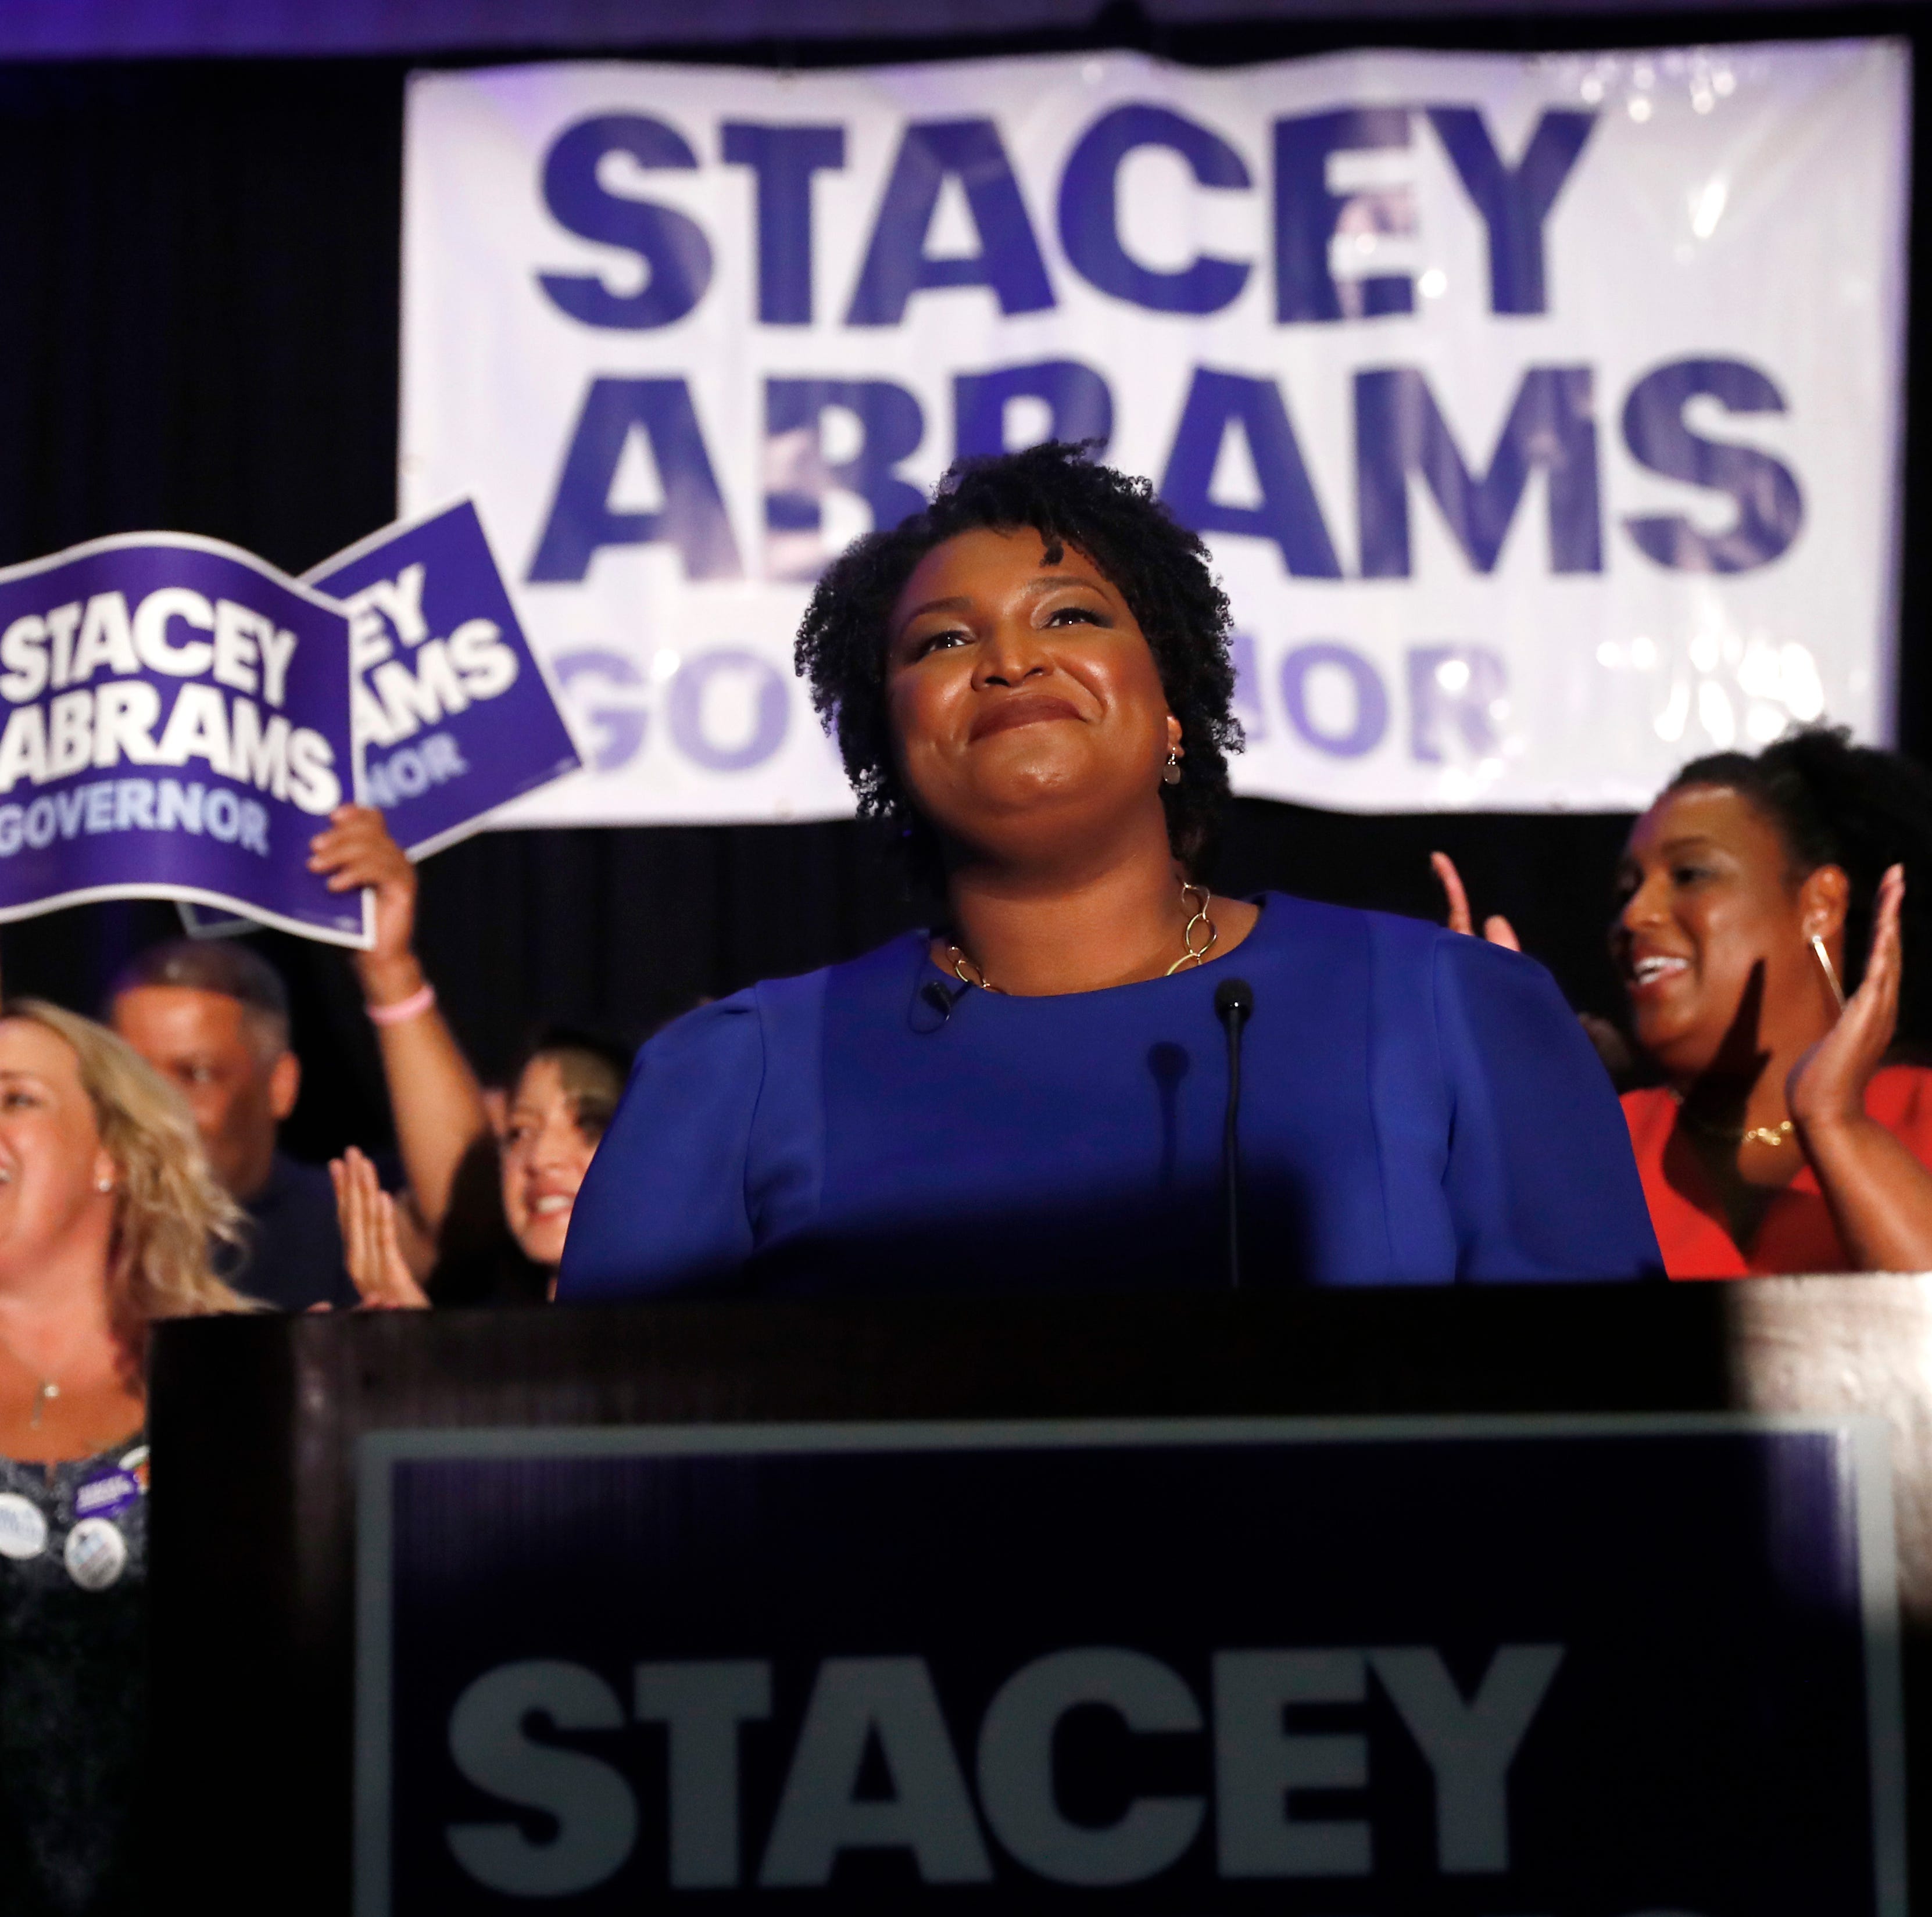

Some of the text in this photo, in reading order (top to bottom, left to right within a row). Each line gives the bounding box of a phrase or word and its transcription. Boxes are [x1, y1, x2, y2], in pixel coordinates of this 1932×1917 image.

[535, 102, 1603, 330] STACEY
[0, 587, 298, 705] STACEY
[352, 617, 519, 748] AMS
[0, 680, 342, 816] ABRAMS
[0, 776, 270, 858] GOVERNOR
[445, 1643, 1566, 1898] STACEY
